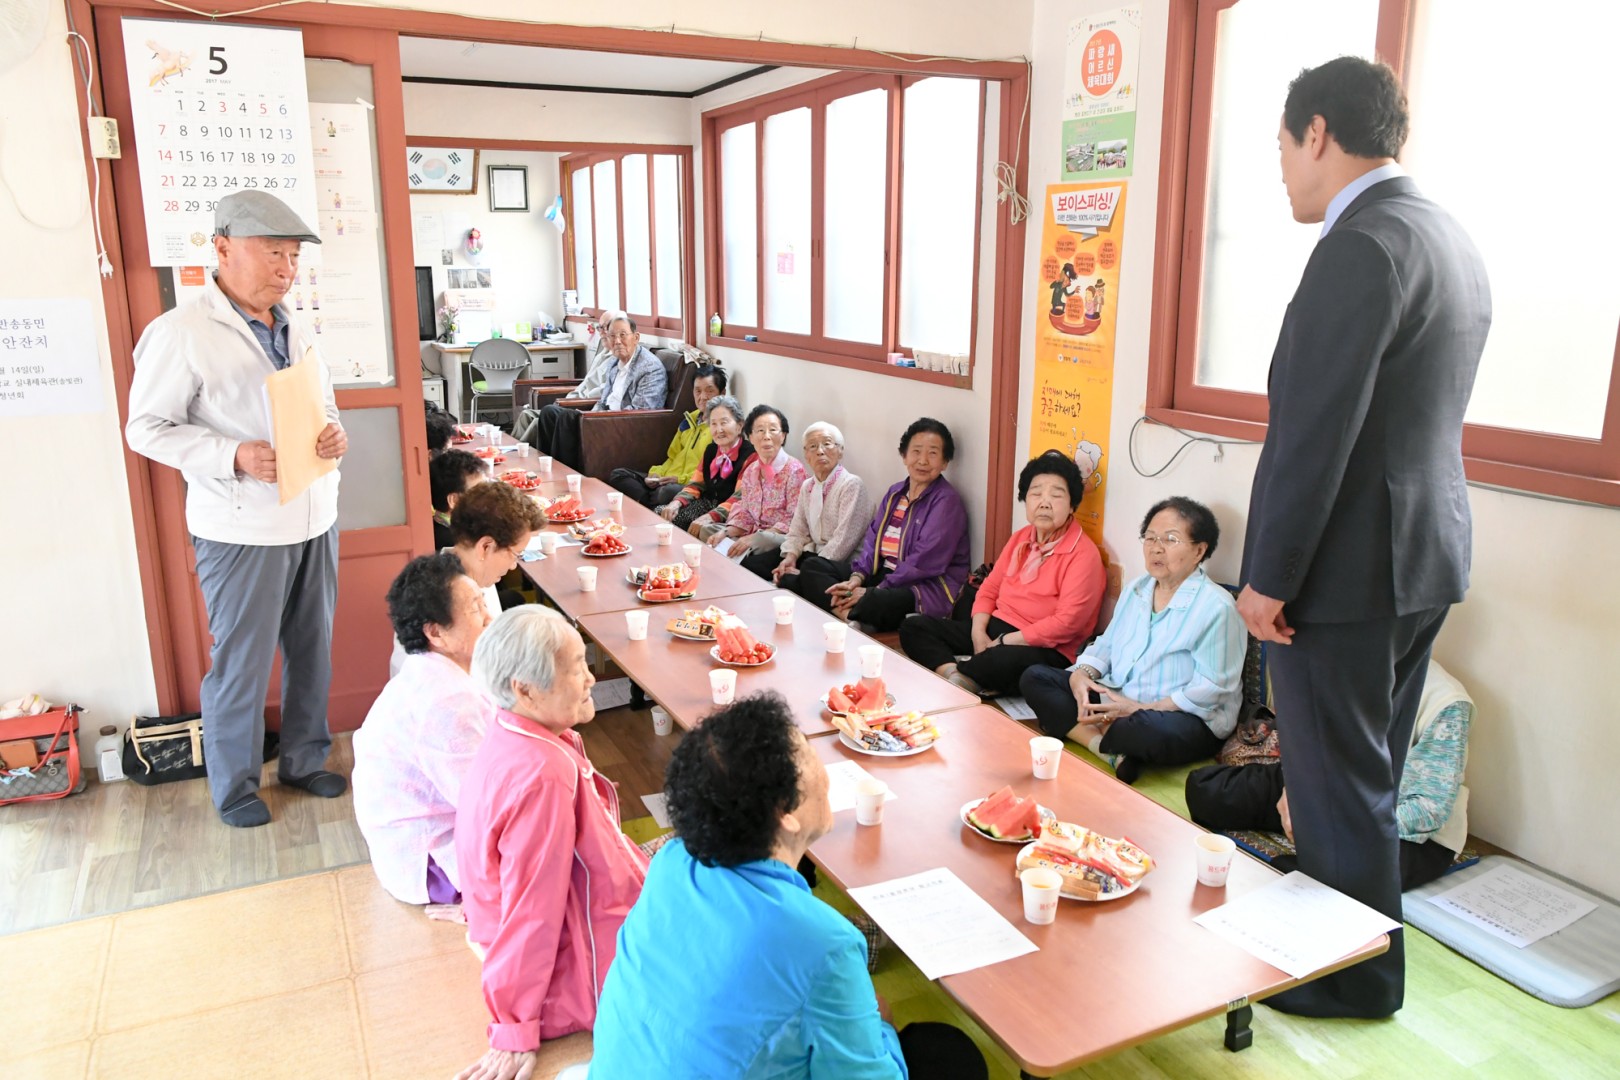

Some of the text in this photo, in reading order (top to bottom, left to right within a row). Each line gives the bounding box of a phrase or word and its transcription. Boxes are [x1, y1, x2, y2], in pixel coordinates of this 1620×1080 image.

[209, 46, 228, 75] 5
[1087, 71, 1114, 88] 체육대회
[178, 100, 287, 115] 1 2 3 4 5 6
[158, 125, 293, 140] 7 8 9 10 11 12 13
[158, 150, 295, 165] 14 15 16 17 18 19 20
[161, 175, 297, 188] 21 22 23 24 25 26 27
[164, 200, 179, 211] 28
[185, 200, 200, 211] 29
[1057, 192, 1113, 211] 보이스피싱!
[11, 365, 45, 375] 14일(일)
[1041, 397, 1081, 418] 궁금하세요?
